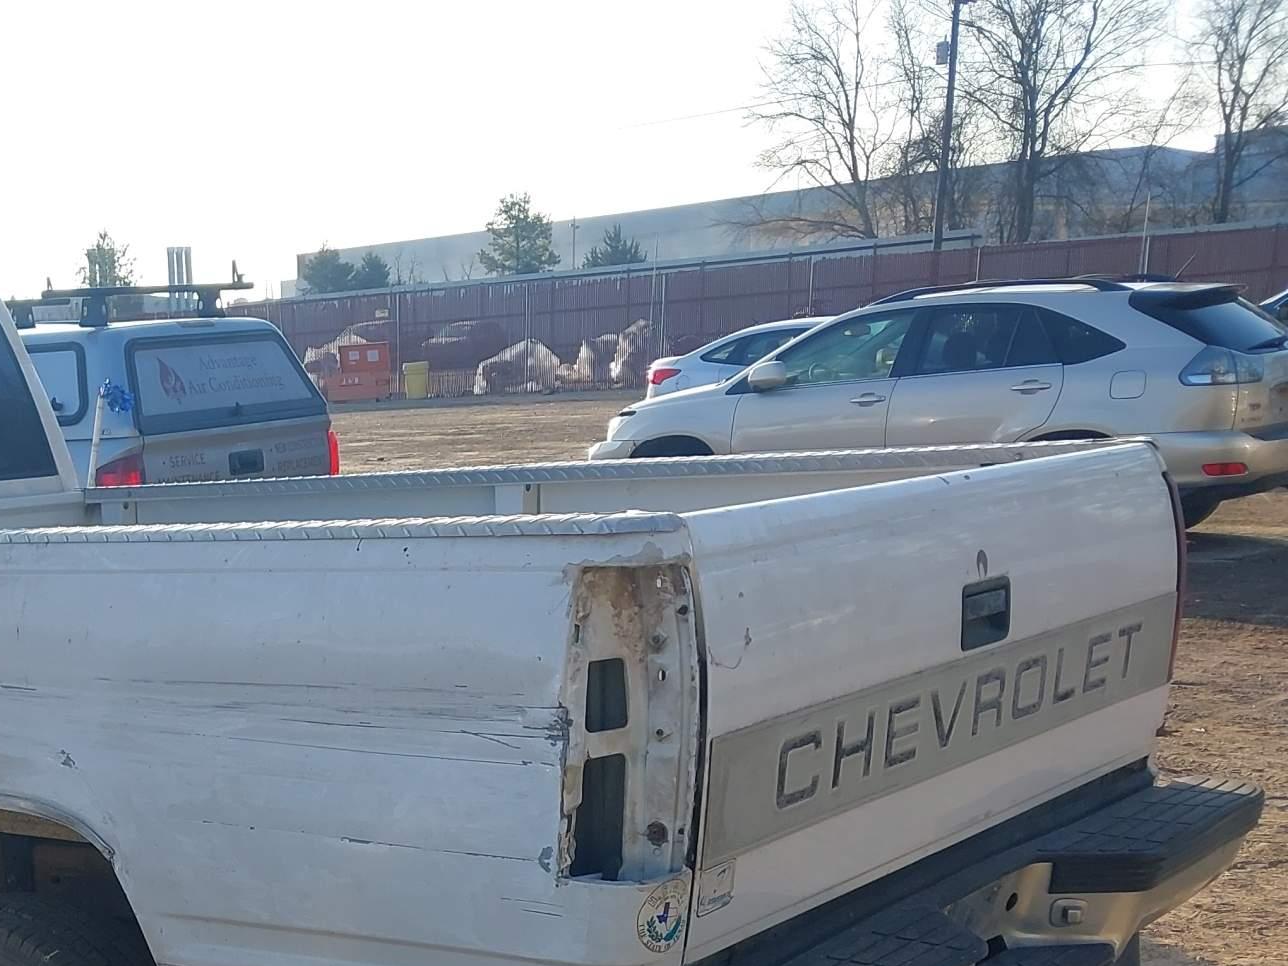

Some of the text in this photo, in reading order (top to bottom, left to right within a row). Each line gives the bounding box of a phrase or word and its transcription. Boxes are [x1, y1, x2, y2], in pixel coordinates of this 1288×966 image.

[199, 354, 258, 370] Advantage
[187, 374, 284, 395] Air Conditioning
[169, 452, 206, 468] SERVICE
[775, 622, 1143, 810] CHEVROLET
